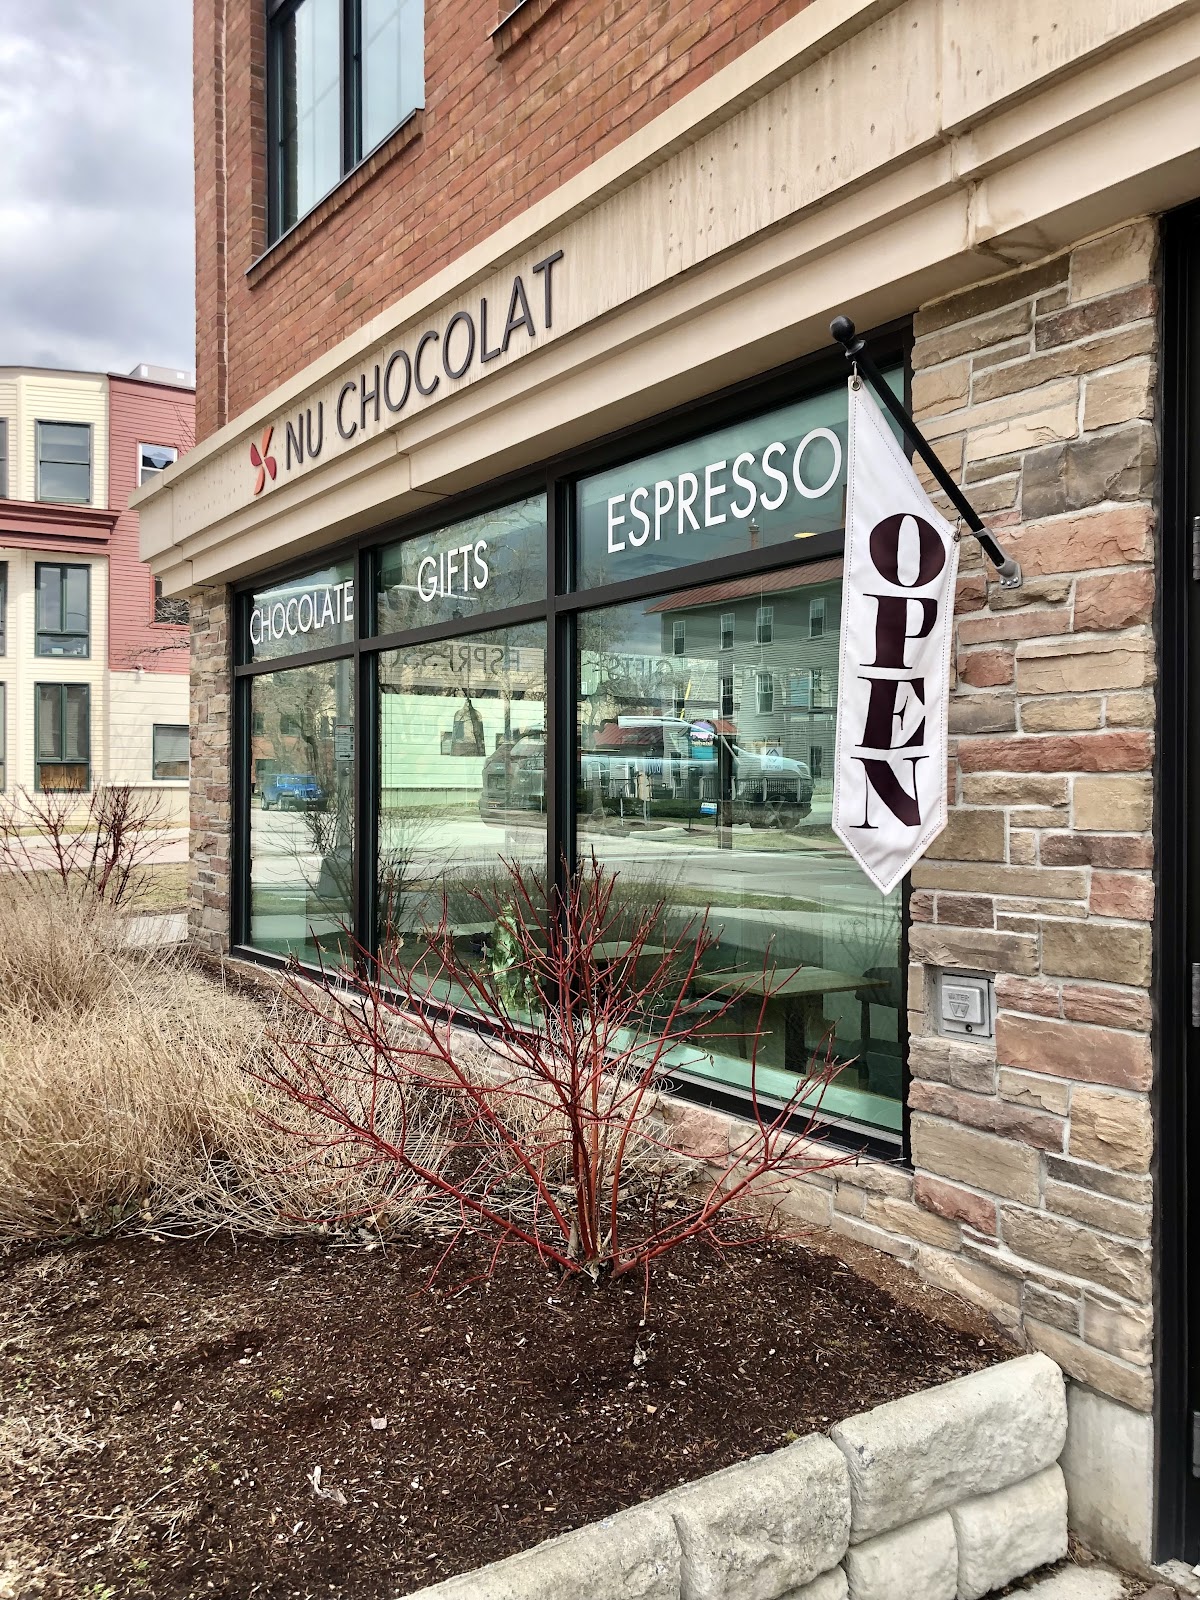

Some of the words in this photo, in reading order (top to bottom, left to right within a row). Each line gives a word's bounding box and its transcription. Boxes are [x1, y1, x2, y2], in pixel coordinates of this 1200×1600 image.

[286, 401, 323, 470] NU
[337, 250, 564, 439] CHOCOLAT
[607, 427, 842, 554] ESPRESSO
[250, 580, 354, 645] CHOCOLATE
[417, 539, 489, 602] GIFTS
[849, 512, 947, 829] OPEN
